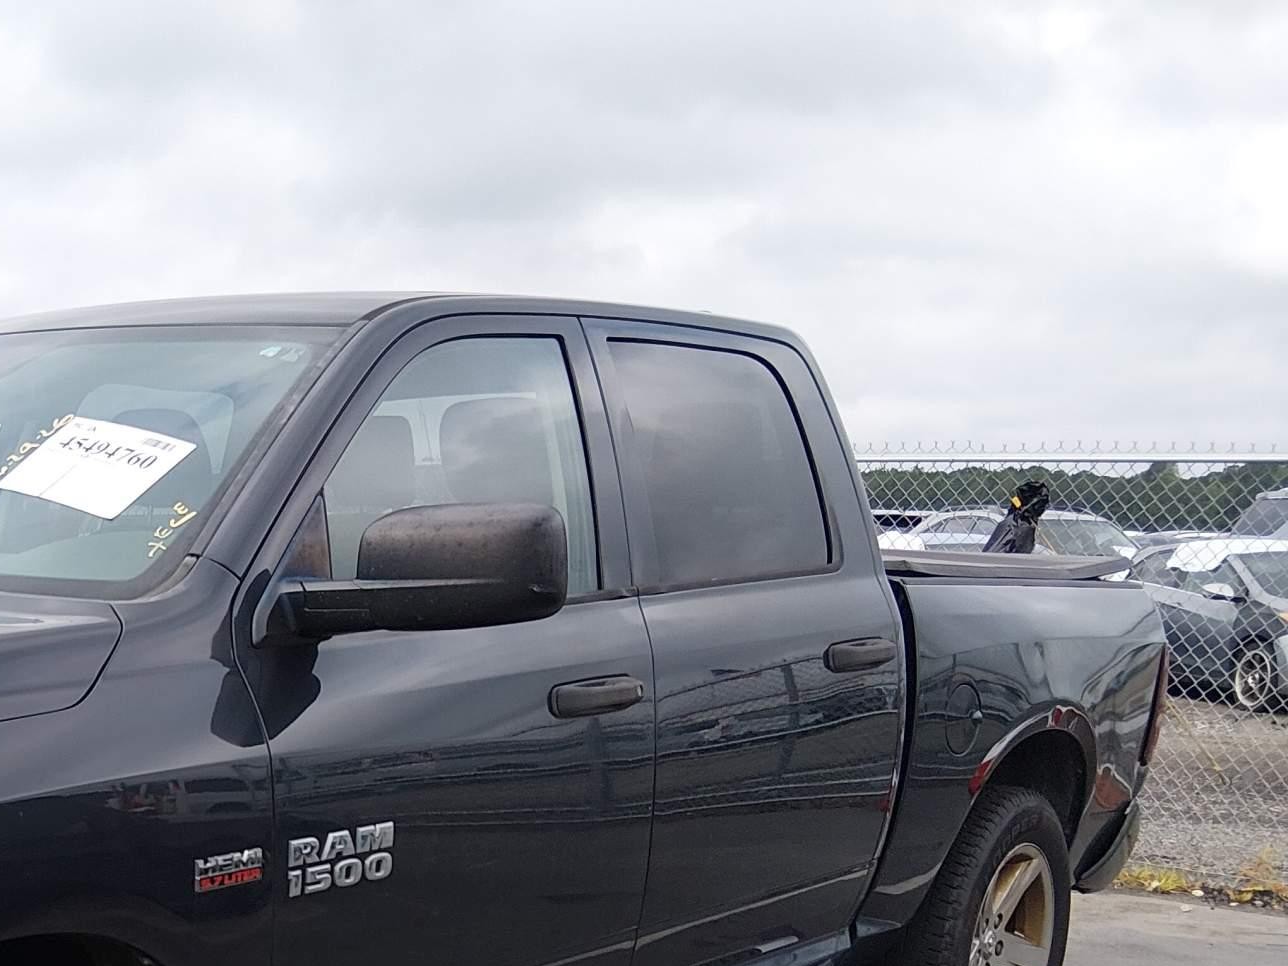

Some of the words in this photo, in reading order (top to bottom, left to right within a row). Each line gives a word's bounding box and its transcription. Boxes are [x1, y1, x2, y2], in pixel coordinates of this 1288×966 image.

[59, 435, 158, 469] 45494760
[194, 847, 263, 877] HEMI
[288, 821, 394, 867] RAM
[288, 852, 393, 898] 1500
